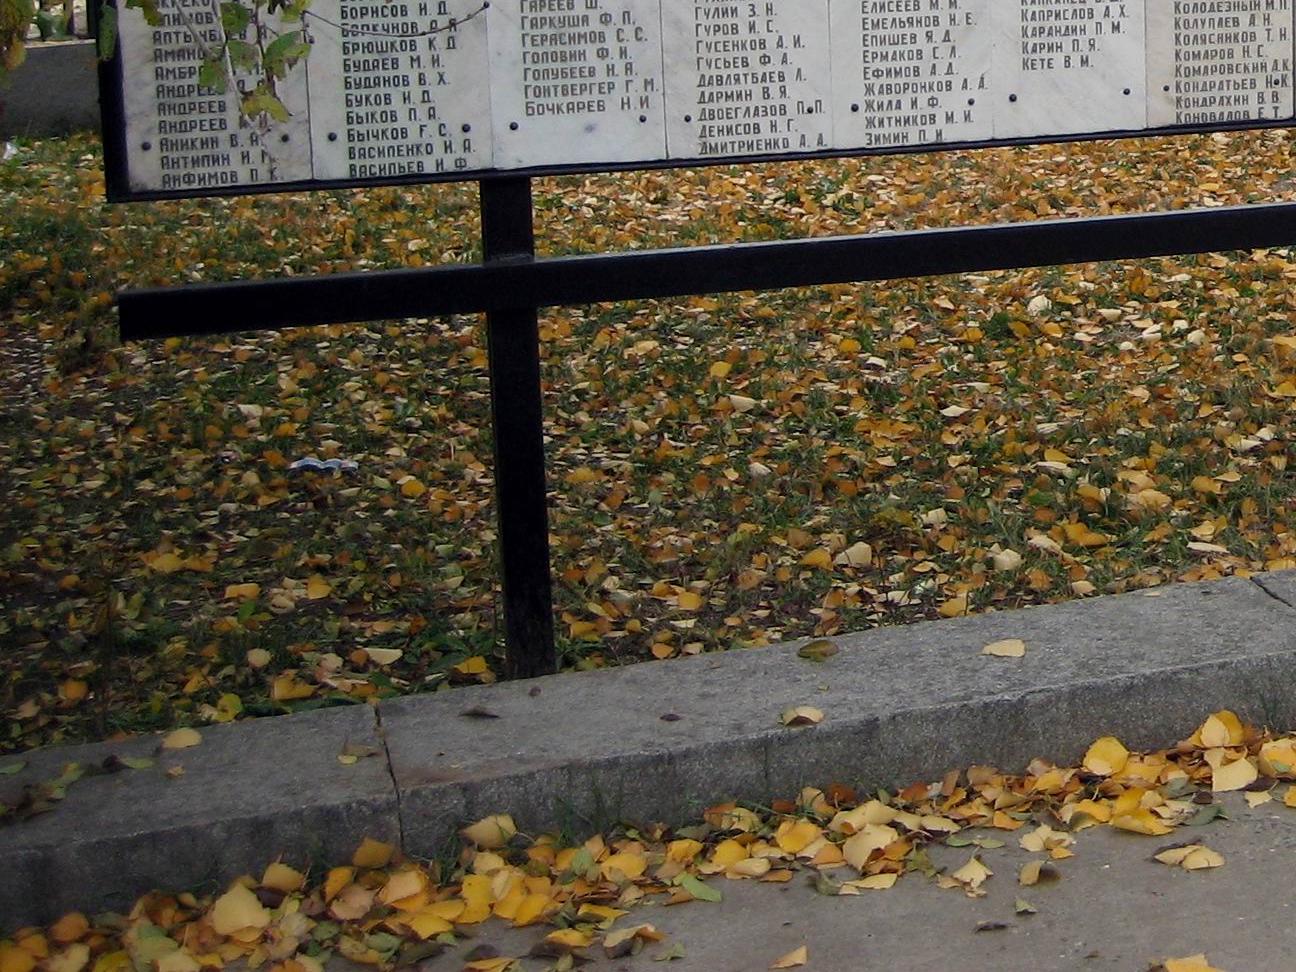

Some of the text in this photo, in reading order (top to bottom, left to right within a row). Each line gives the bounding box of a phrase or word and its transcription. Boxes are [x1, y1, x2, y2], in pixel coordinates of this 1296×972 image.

[862, 0, 920, 14] ЕЛИСЕЕВ
[521, 15, 590, 30] ГАРКУША
[695, 23, 738, 37] ГУРОВ
[862, 17, 939, 30] ЕМЕЛЬЯНОВ
[522, 31, 606, 47] ГЕРАСИМОВ
[343, 40, 417, 55] БРЮШКОВ
[1022, 41, 1062, 54] КАРИН
[1175, 48, 1234, 62] КОМАРОВ
[863, 49, 923, 63] ЕРМАКОВ
[1022, 57, 1054, 70] КЕТЕ
[343, 57, 399, 73] БУДАЕВ
[697, 71, 785, 87] ДАВЛЯТБАЕВ
[864, 80, 952, 96] ЖАВОРОНКОВ
[345, 93, 392, 108] БУКОВ
[698, 89, 752, 104] ДАРМИН
[158, 101, 226, 116] АНДРЕЕВ
[526, 100, 606, 116] БОЧКАРЕВ
[347, 110, 398, 125] БЫКОВ
[698, 122, 760, 138] ДЕНИСОВ
[160, 136, 218, 152] АНИКИН
[698, 137, 789, 155] ДМИТРИЕНКО
[162, 170, 238, 188] АНФИМОВ
